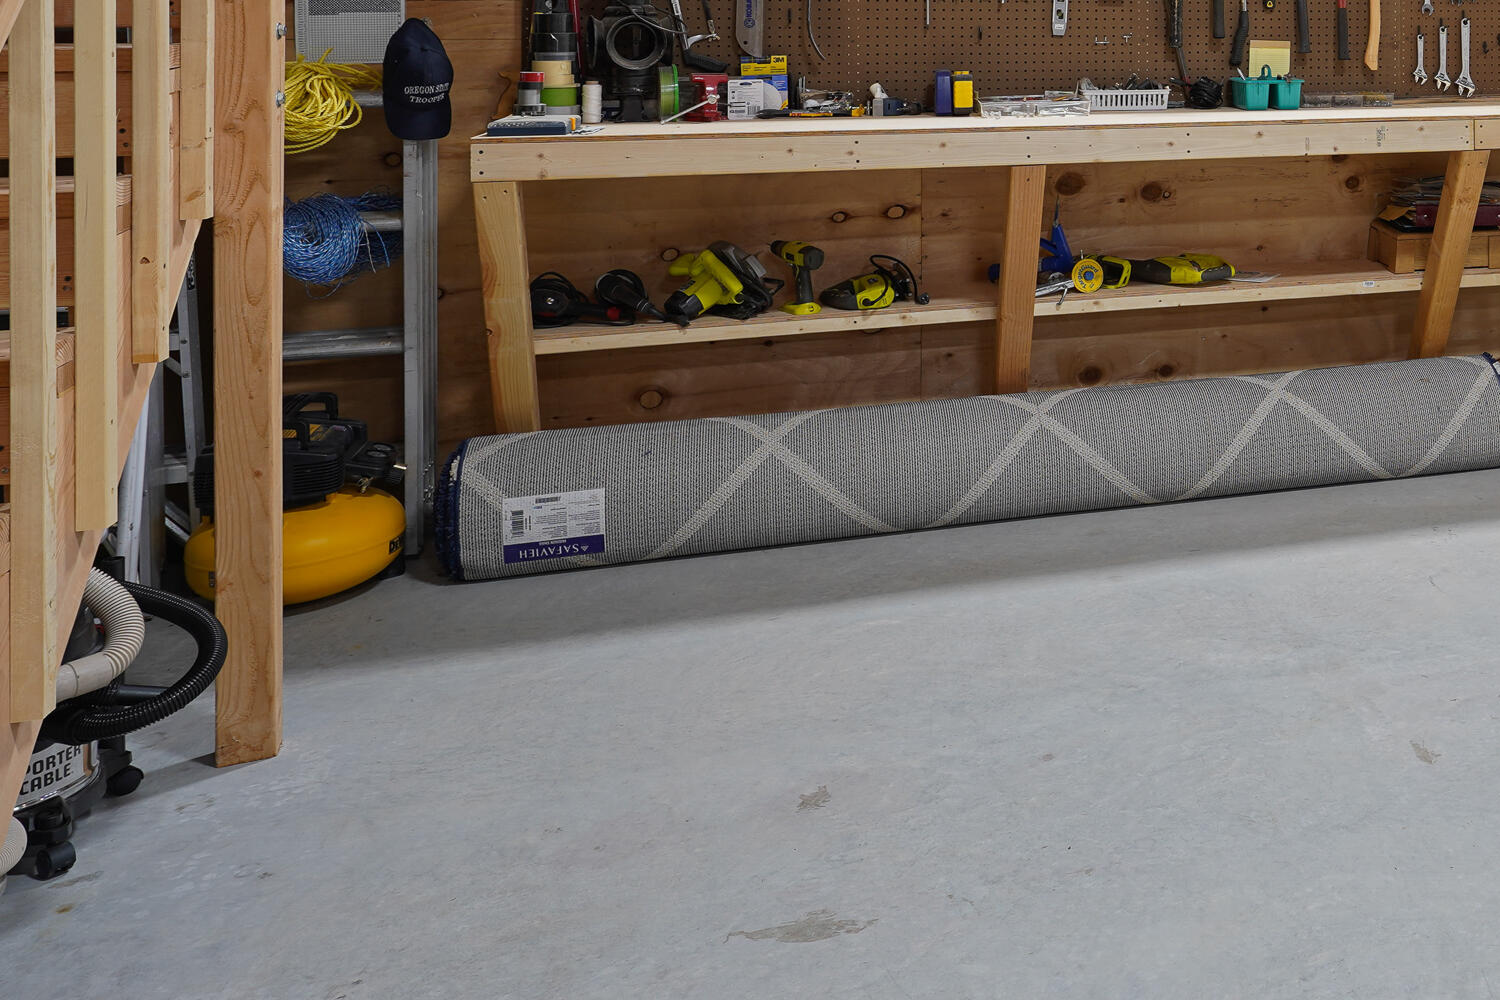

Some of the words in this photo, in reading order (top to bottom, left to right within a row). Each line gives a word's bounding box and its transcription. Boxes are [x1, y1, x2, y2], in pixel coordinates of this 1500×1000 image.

[404, 85, 435, 95] OREGON
[519, 543, 579, 559] SAFAVIEH
[19, 762, 71, 796] CABLE
